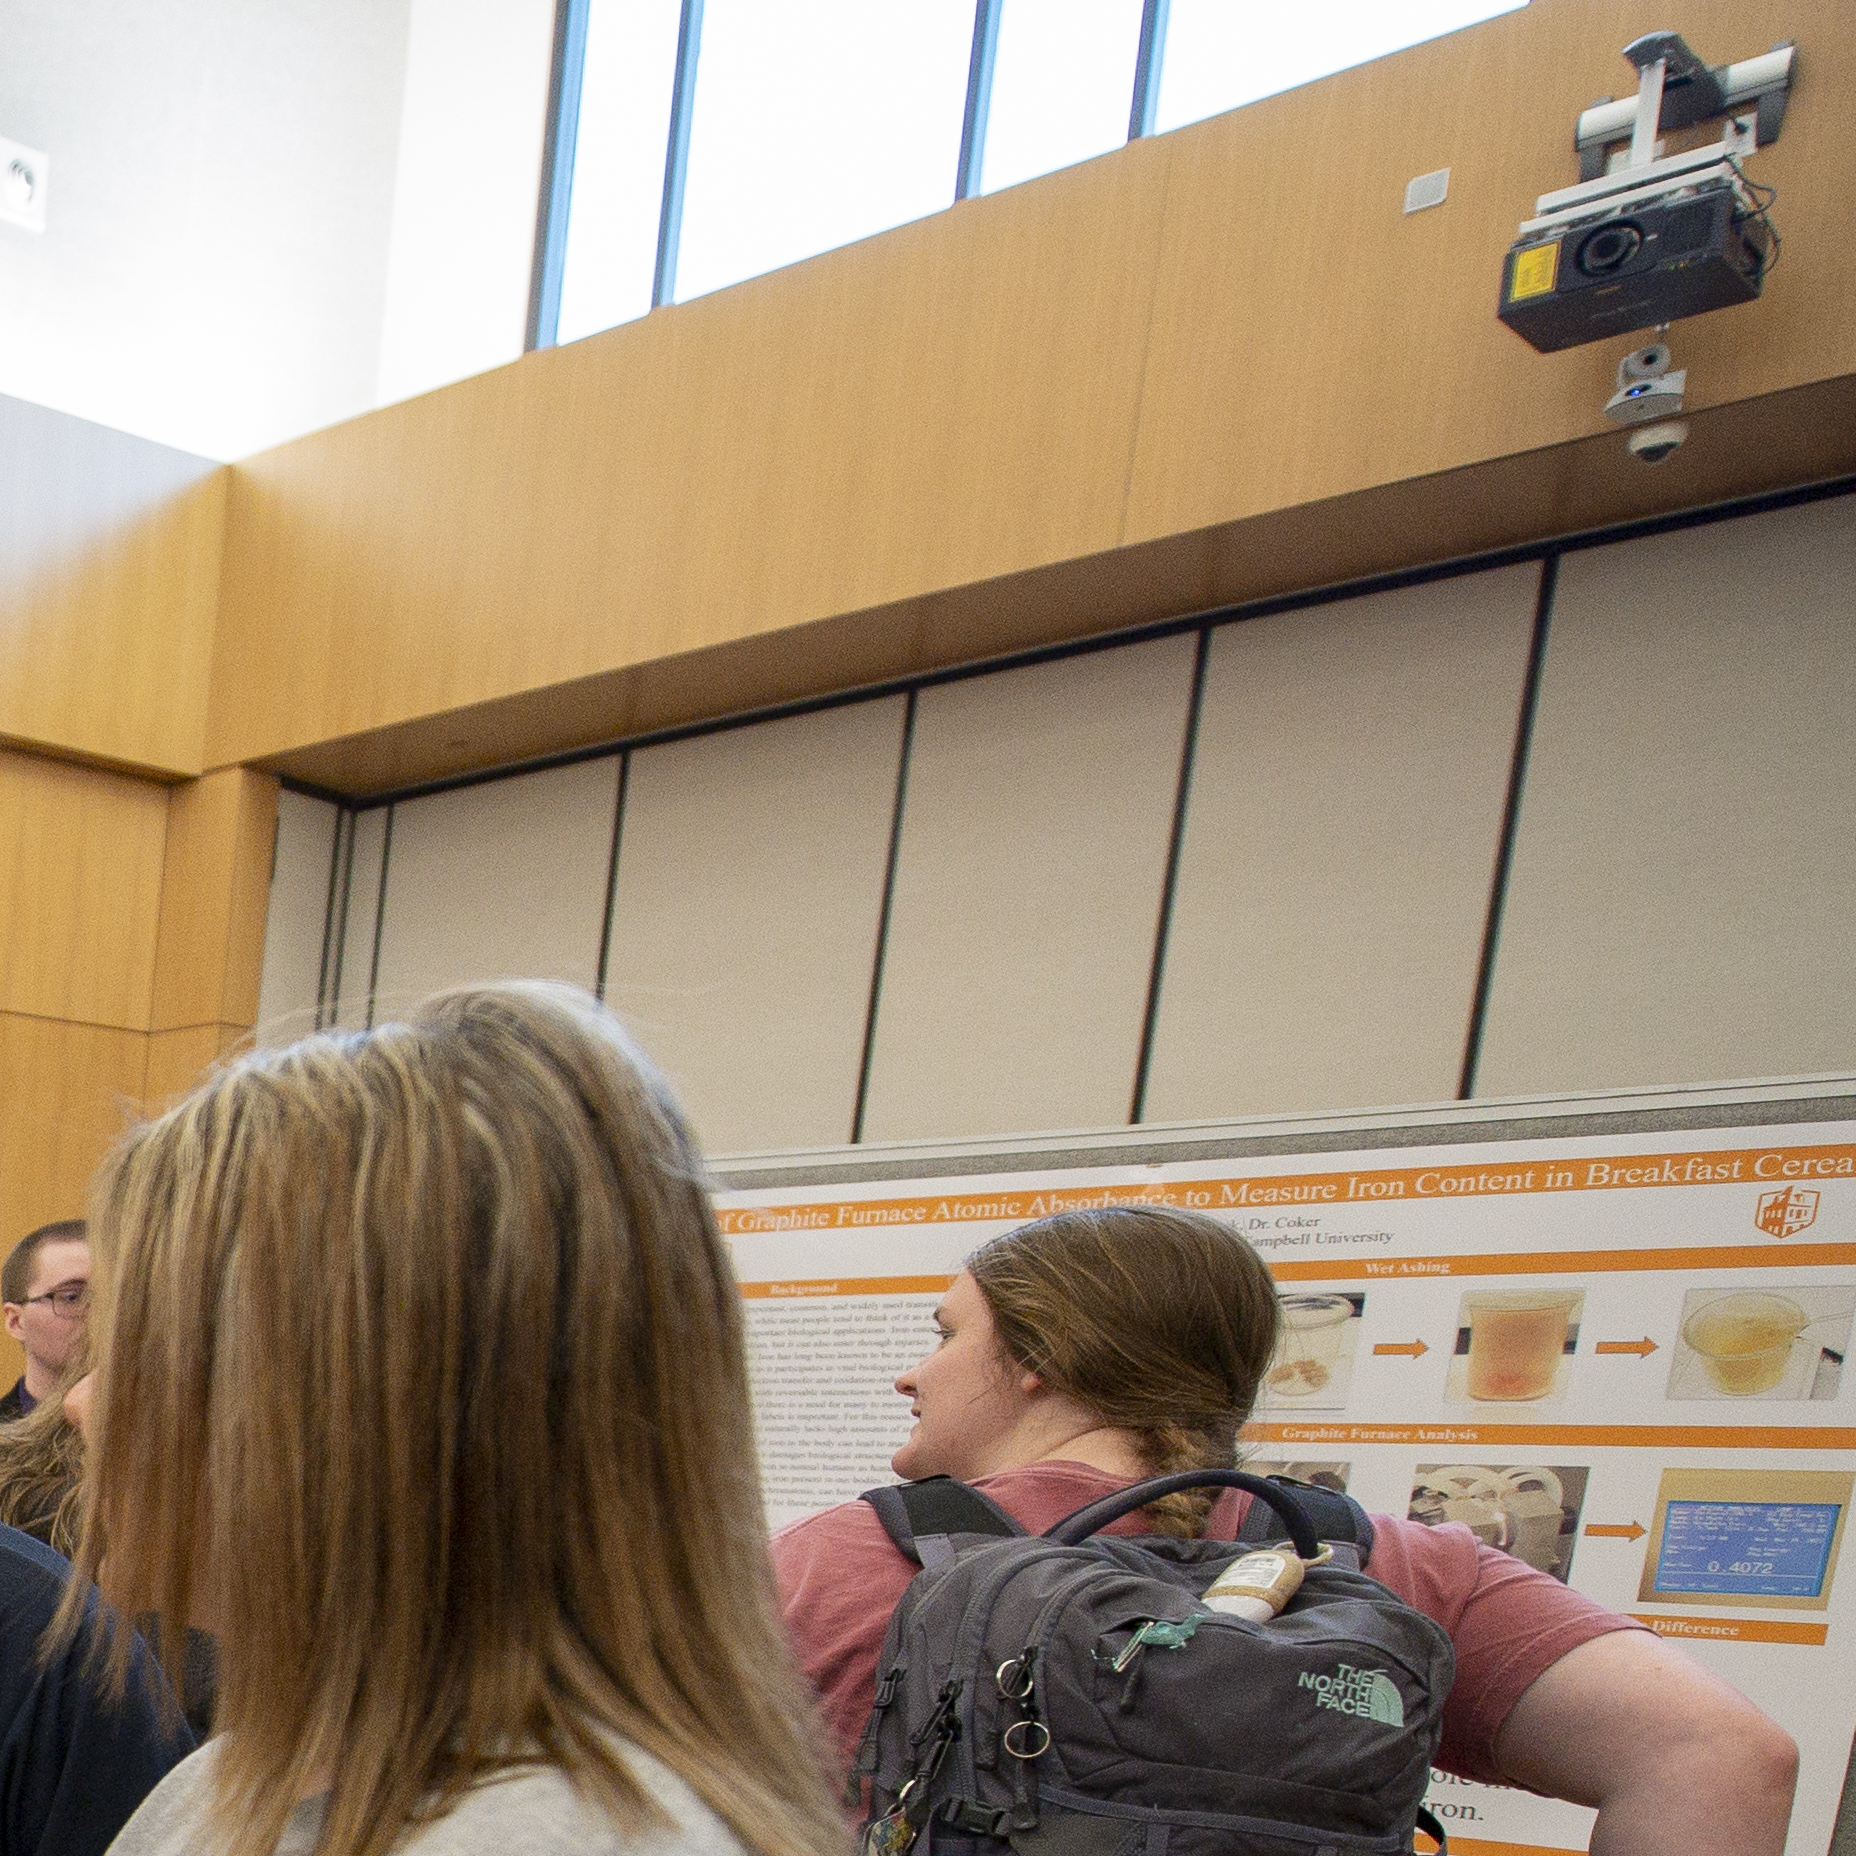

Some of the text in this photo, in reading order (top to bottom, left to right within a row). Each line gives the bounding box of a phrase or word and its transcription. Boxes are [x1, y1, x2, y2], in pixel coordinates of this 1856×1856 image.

[738, 1204, 829, 1232] Graphite
[837, 1203, 927, 1226] Furnace
[934, 1198, 1020, 1222] Atomic
[1187, 1189, 1211, 1207] to
[1219, 1181, 1337, 1205] Measure
[1348, 1176, 1407, 1198] Iron
[1414, 1170, 1534, 1195] Content
[1544, 1165, 1574, 1189] in
[1586, 1156, 1742, 1187] Breakfast
[1247, 1230, 1395, 1249] ampbell University
[1707, 1560, 1774, 1574] 0.4072
[1652, 1618, 1740, 1636] Difference
[1298, 1671, 1371, 1703] NORTH
[1338, 1663, 1373, 1688] THE
[1316, 1691, 1372, 1718] FACE
